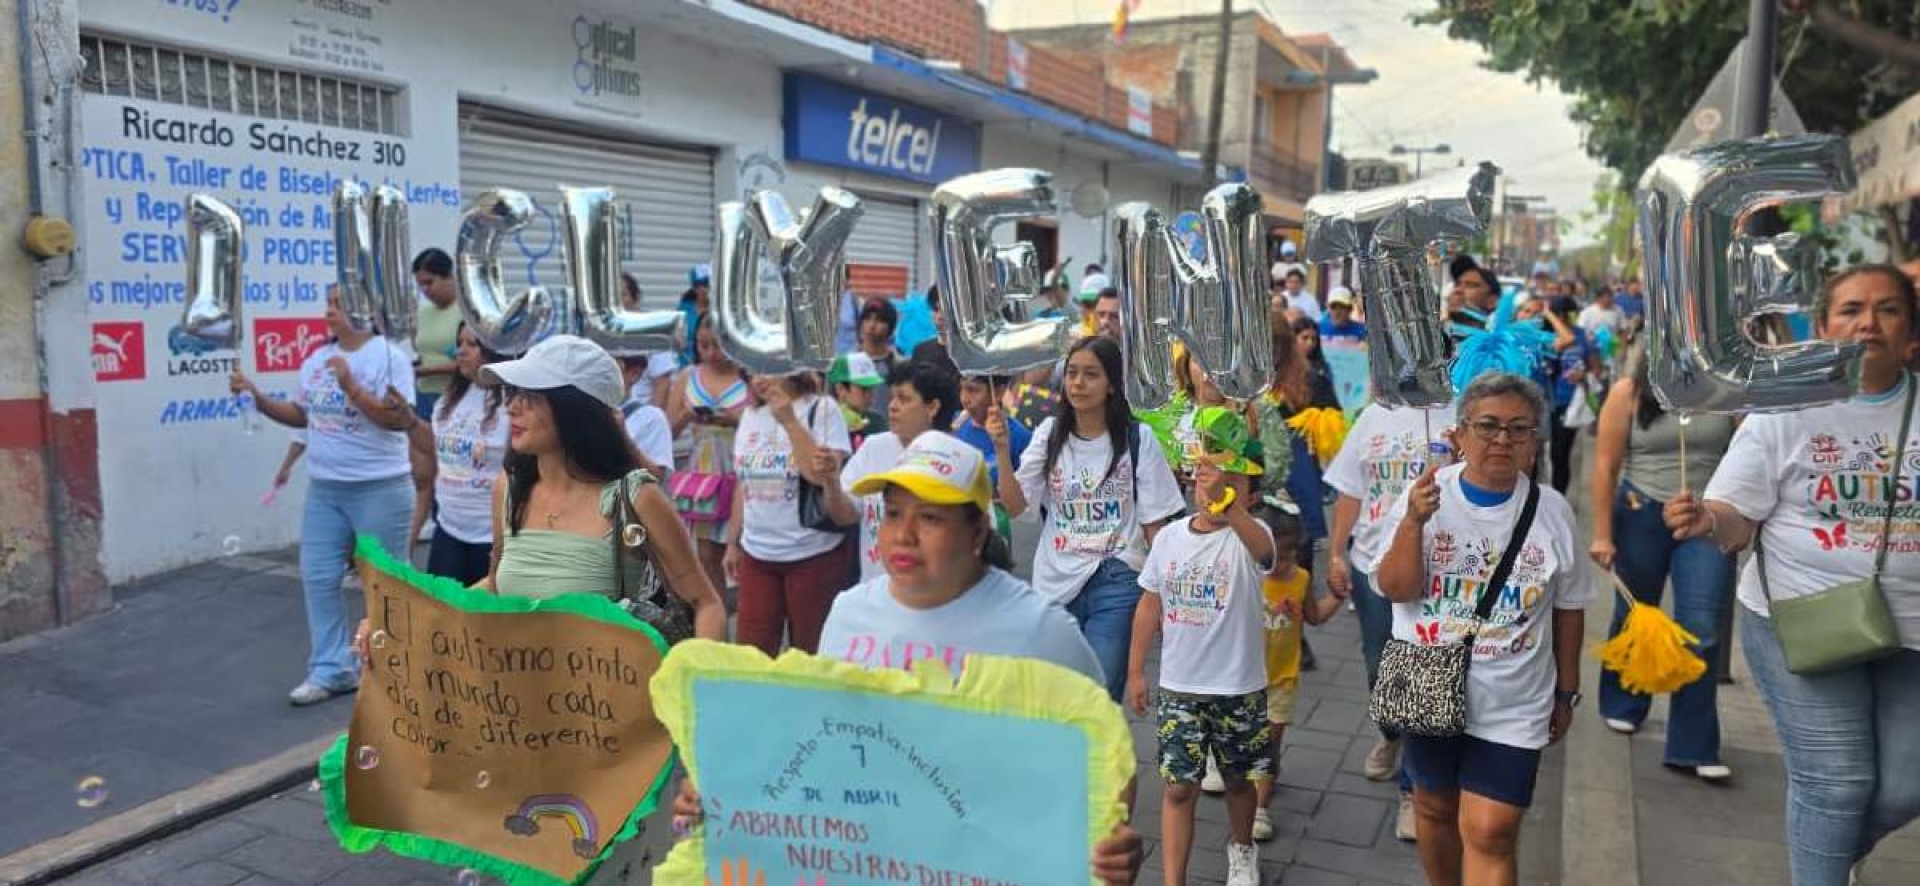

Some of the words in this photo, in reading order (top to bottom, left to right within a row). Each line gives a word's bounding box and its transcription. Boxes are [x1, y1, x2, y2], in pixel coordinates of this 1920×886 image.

[122, 105, 235, 147] Ricardo
[249, 123, 361, 161] Sánchez
[373, 141, 406, 167] 310
[848, 98, 941, 175] telcel
[165, 154, 231, 188] Taller
[239, 163, 267, 191] de
[405, 178, 461, 206] Lentes
[106, 197, 122, 224] y
[279, 203, 304, 228] de
[110, 274, 186, 309] mejore
[278, 280, 289, 310] y
[382, 596, 412, 647] El
[431, 629, 555, 672] autismo
[567, 647, 639, 687] pinta
[387, 652, 410, 682] el
[425, 668, 520, 718] mundo
[547, 685, 616, 722] cada
[434, 703, 464, 729] de
[479, 719, 622, 754] diferente
[849, 744, 866, 768] 7
[801, 785, 824, 803] DE
[844, 788, 901, 807] ABRIL
[729, 810, 870, 844] ABRACEMOS
[787, 843, 911, 882] NUESTRAS
